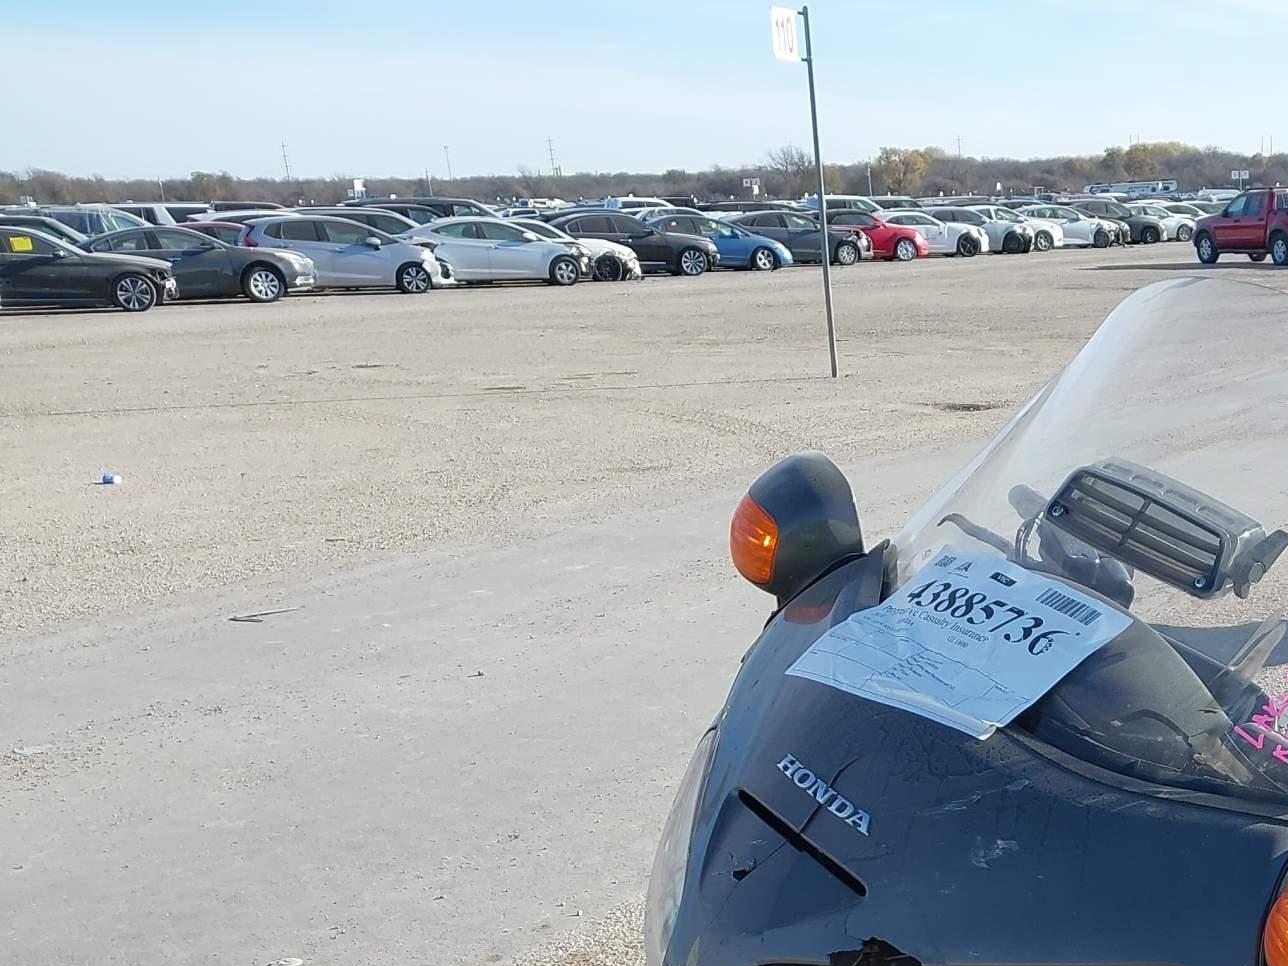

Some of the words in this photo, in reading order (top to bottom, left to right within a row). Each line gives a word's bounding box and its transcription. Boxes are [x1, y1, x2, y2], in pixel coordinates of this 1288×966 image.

[775, 16, 794, 54] 110
[907, 580, 1070, 655] 43885736
[919, 610, 950, 629] Casualty
[950, 622, 990, 642] Insurance
[776, 753, 870, 836] HONDA
